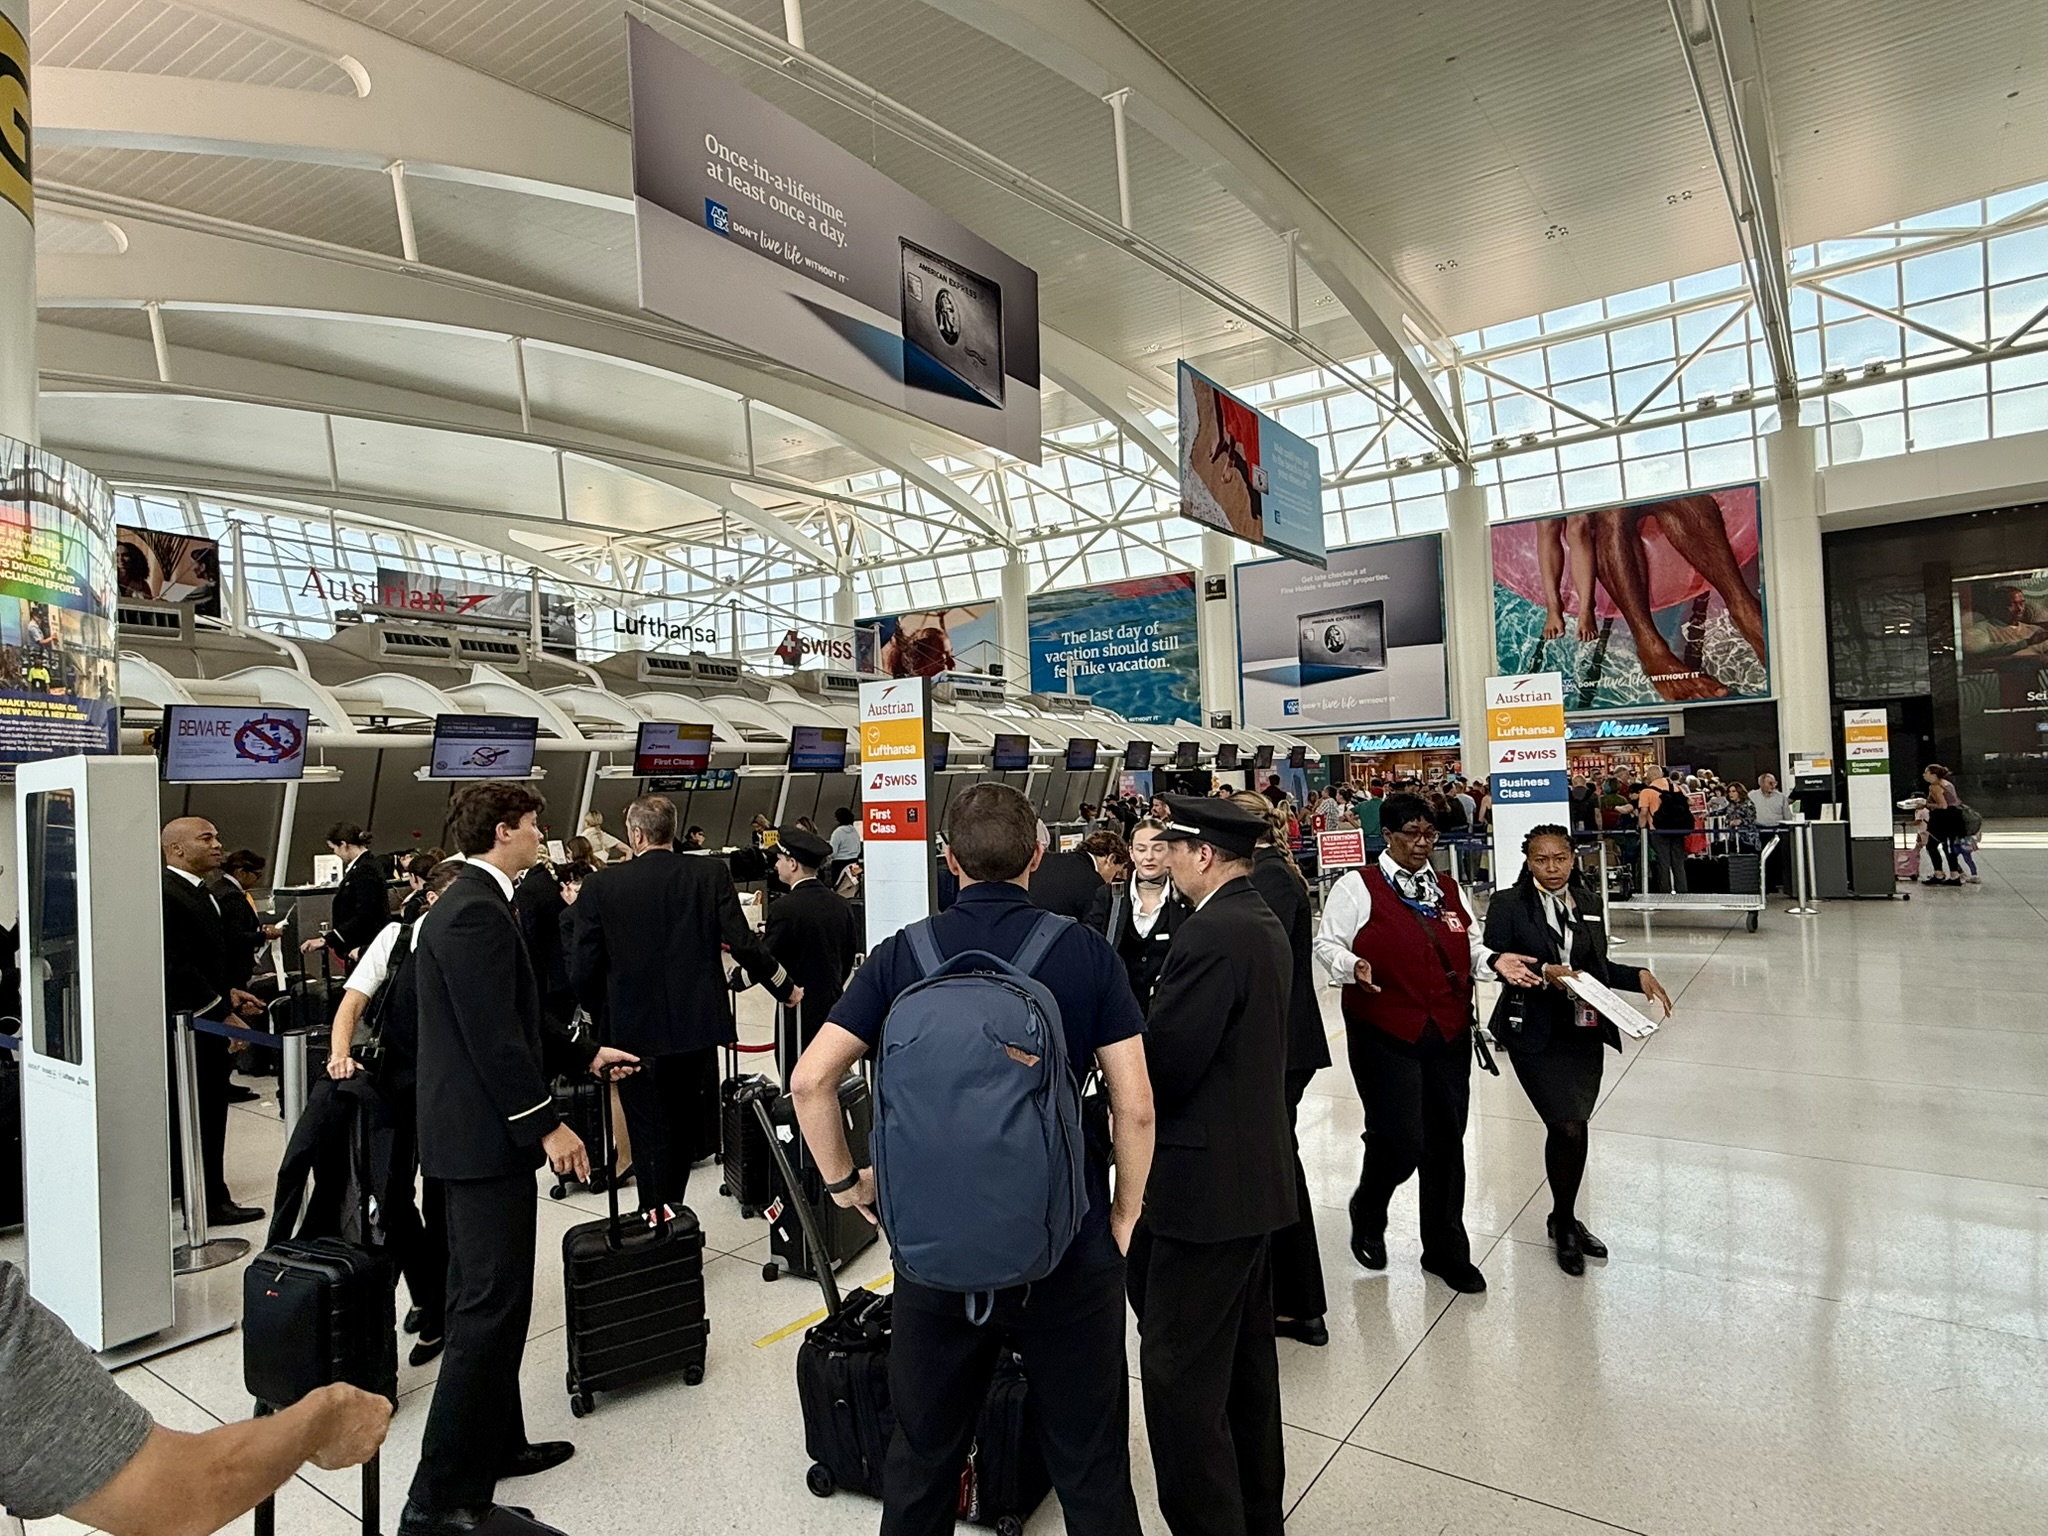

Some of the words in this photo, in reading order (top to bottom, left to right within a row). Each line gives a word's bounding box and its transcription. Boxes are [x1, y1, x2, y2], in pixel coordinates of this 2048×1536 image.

[705, 134, 847, 227] Once-in-a-lifetime,
[706, 161, 724, 183] at
[727, 167, 766, 205] least
[769, 195, 805, 225] once
[808, 216, 817, 232] a
[820, 220, 848, 248] day.
[732, 222, 758, 242] DON'T
[760, 229, 783, 255] live
[784, 242, 804, 265] life
[804, 257, 838, 280] WITHOUT
[918, 262, 948, 286] AMERICAN
[948, 278, 978, 299] EXPRESS
[11, 561, 57, 579] DIVERSITY
[57, 573, 75, 584] AND
[50, 560, 68, 572] FOR
[1301, 575, 1314, 584] Get
[1314, 573, 1327, 582] late
[1327, 568, 1358, 580] checkout
[1359, 567, 1367, 576] at
[299, 566, 446, 613] Austrian
[1280, 587, 1294, 595] Fine
[1295, 584, 1316, 593] Hotels
[1353, 573, 1391, 586] properties.
[613, 610, 717, 644] Lufthansa
[1061, 631, 1087, 646] The
[1090, 628, 1114, 643] last
[1116, 624, 1142, 642] day
[1144, 620, 1160, 636] of
[799, 636, 852, 660] SWISS
[1102, 638, 1149, 658] should
[1151, 635, 1179, 652] still
[1053, 664, 1079, 679] fel
[1107, 656, 1171, 674] vacation.
[1651, 672, 1689, 682] WITHOUT
[1691, 671, 1700, 679] IT
[26, 700, 48, 709] YOUR
[48, 702, 67, 711] MARK
[1321, 697, 1341, 710] live
[1341, 695, 1357, 709] life
[1358, 696, 1388, 705] WITHOUT
[1495, 691, 1552, 704] Austrian
[0, 707, 21, 716] NEW
[22, 708, 43, 718] YORK
[51, 711, 65, 719] NEW
[867, 701, 914, 717] Austrian
[178, 719, 232, 737] BEWARE
[1497, 725, 1556, 737] Lufthansa
[1596, 720, 1660, 738] News
[1347, 734, 1411, 752] Hudson
[1411, 732, 1462, 748] News
[868, 744, 916, 758] Lufthansa
[1517, 749, 1557, 761] SWISS
[654, 758, 672, 766] First
[672, 758, 695, 766] Class
[1852, 761, 1882, 769] Economy
[884, 773, 918, 788] SWISS
[1499, 777, 1550, 788] Business
[1499, 789, 1531, 799] Class
[870, 808, 891, 821] First
[870, 822, 897, 834] Class
